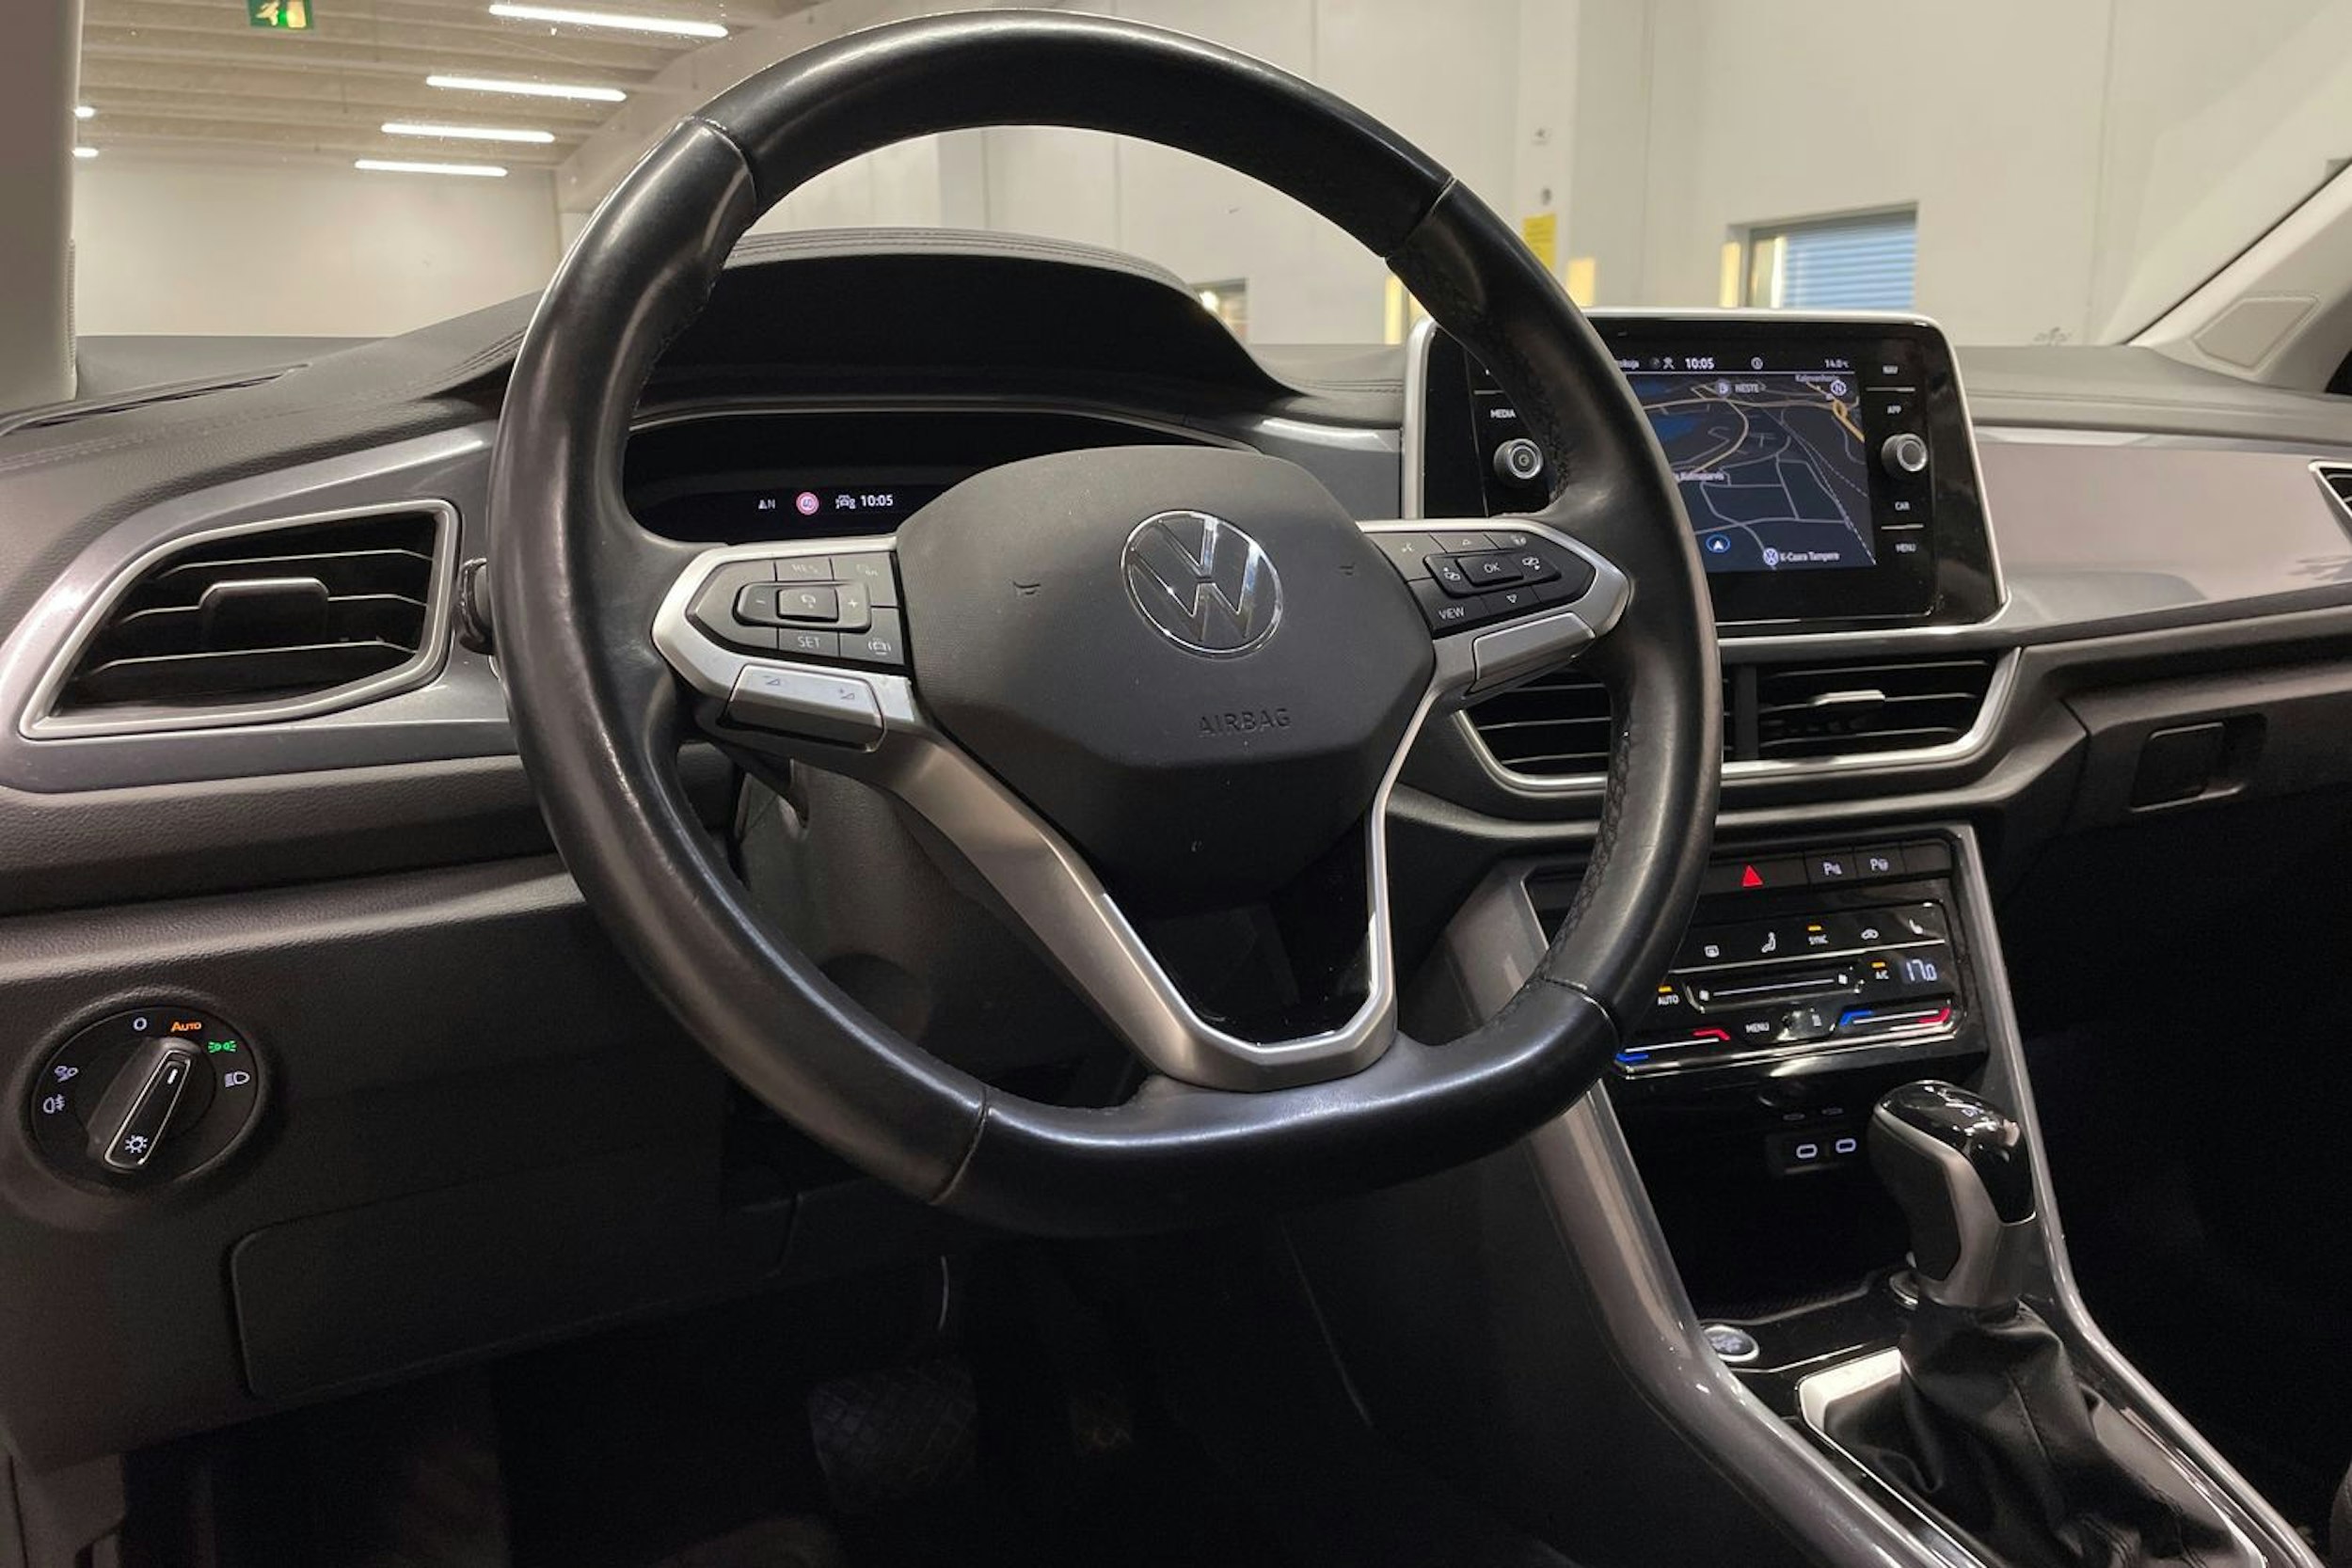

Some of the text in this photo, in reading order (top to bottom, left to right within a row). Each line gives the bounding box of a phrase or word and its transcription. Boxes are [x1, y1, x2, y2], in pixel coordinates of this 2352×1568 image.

[1684, 356, 1715, 370] 10:05
[1735, 384, 1759, 393] NESTE
[1489, 408, 1517, 420] MEDIA
[1886, 404, 1902, 415] APP
[860, 494, 894, 507] 10:05
[1895, 501, 1910, 511] CAR
[1895, 543, 1917, 553] MENU
[1484, 562, 1502, 574] OK
[1438, 607, 1465, 621] VIEW
[797, 636, 820, 649] SET
[1199, 707, 1292, 736] AIRBAG
[1658, 994, 1679, 1006] AUTO
[1745, 1022, 1771, 1034] MENU
